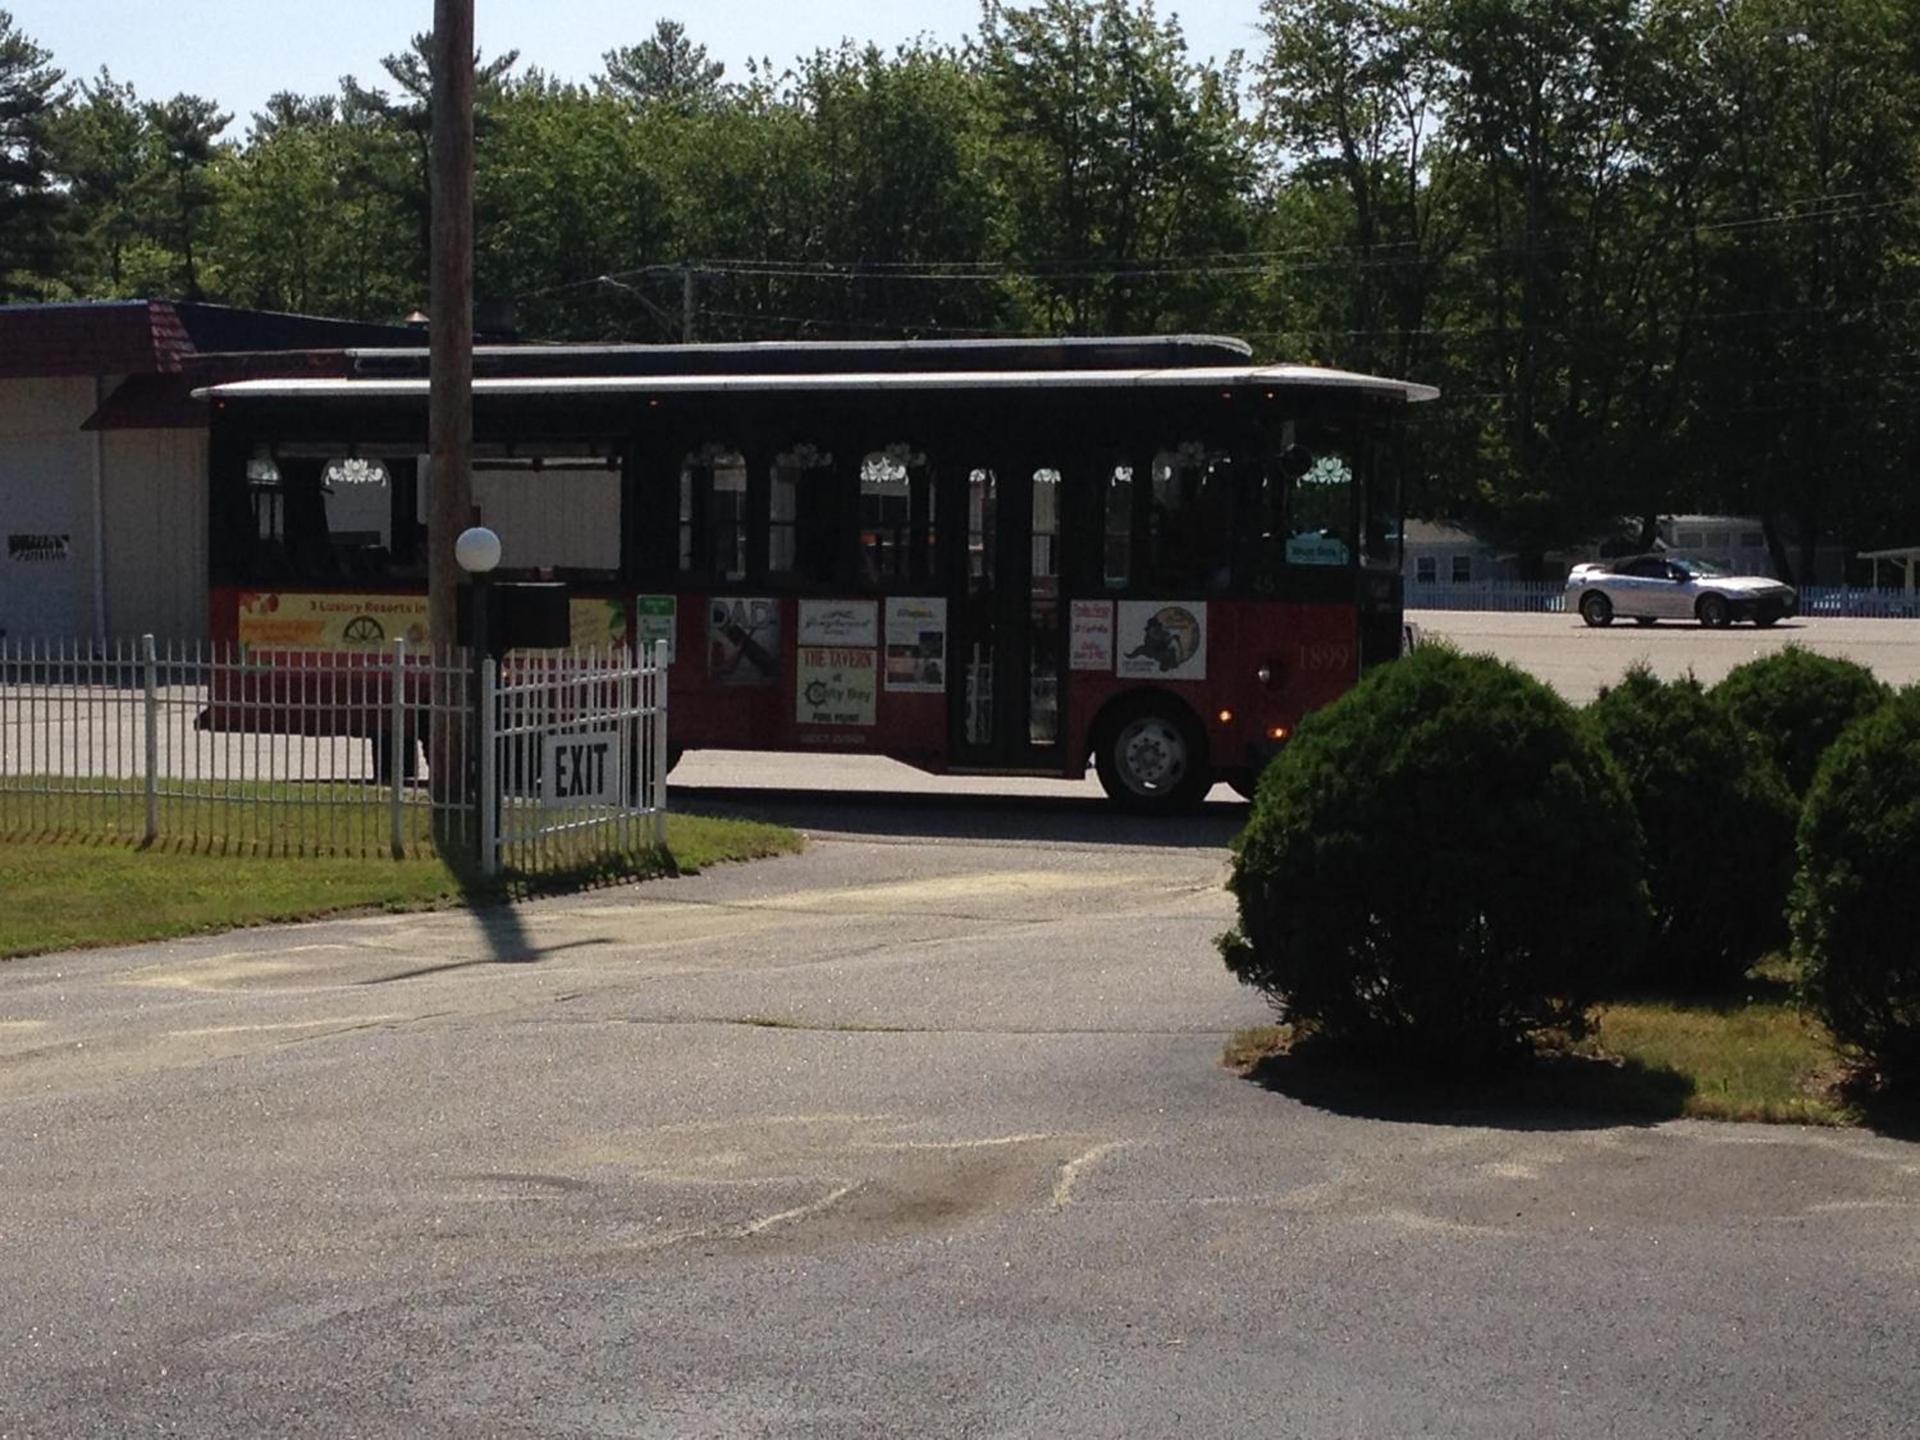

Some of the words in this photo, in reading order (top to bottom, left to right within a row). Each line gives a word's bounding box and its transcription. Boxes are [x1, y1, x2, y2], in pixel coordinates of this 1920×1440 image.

[319, 601, 362, 614] Luxury
[365, 602, 412, 614] Resorts
[804, 651, 827, 668] THE
[830, 651, 872, 668] TAVERN
[1299, 645, 1350, 671] 1899
[555, 743, 608, 797] EXIT
